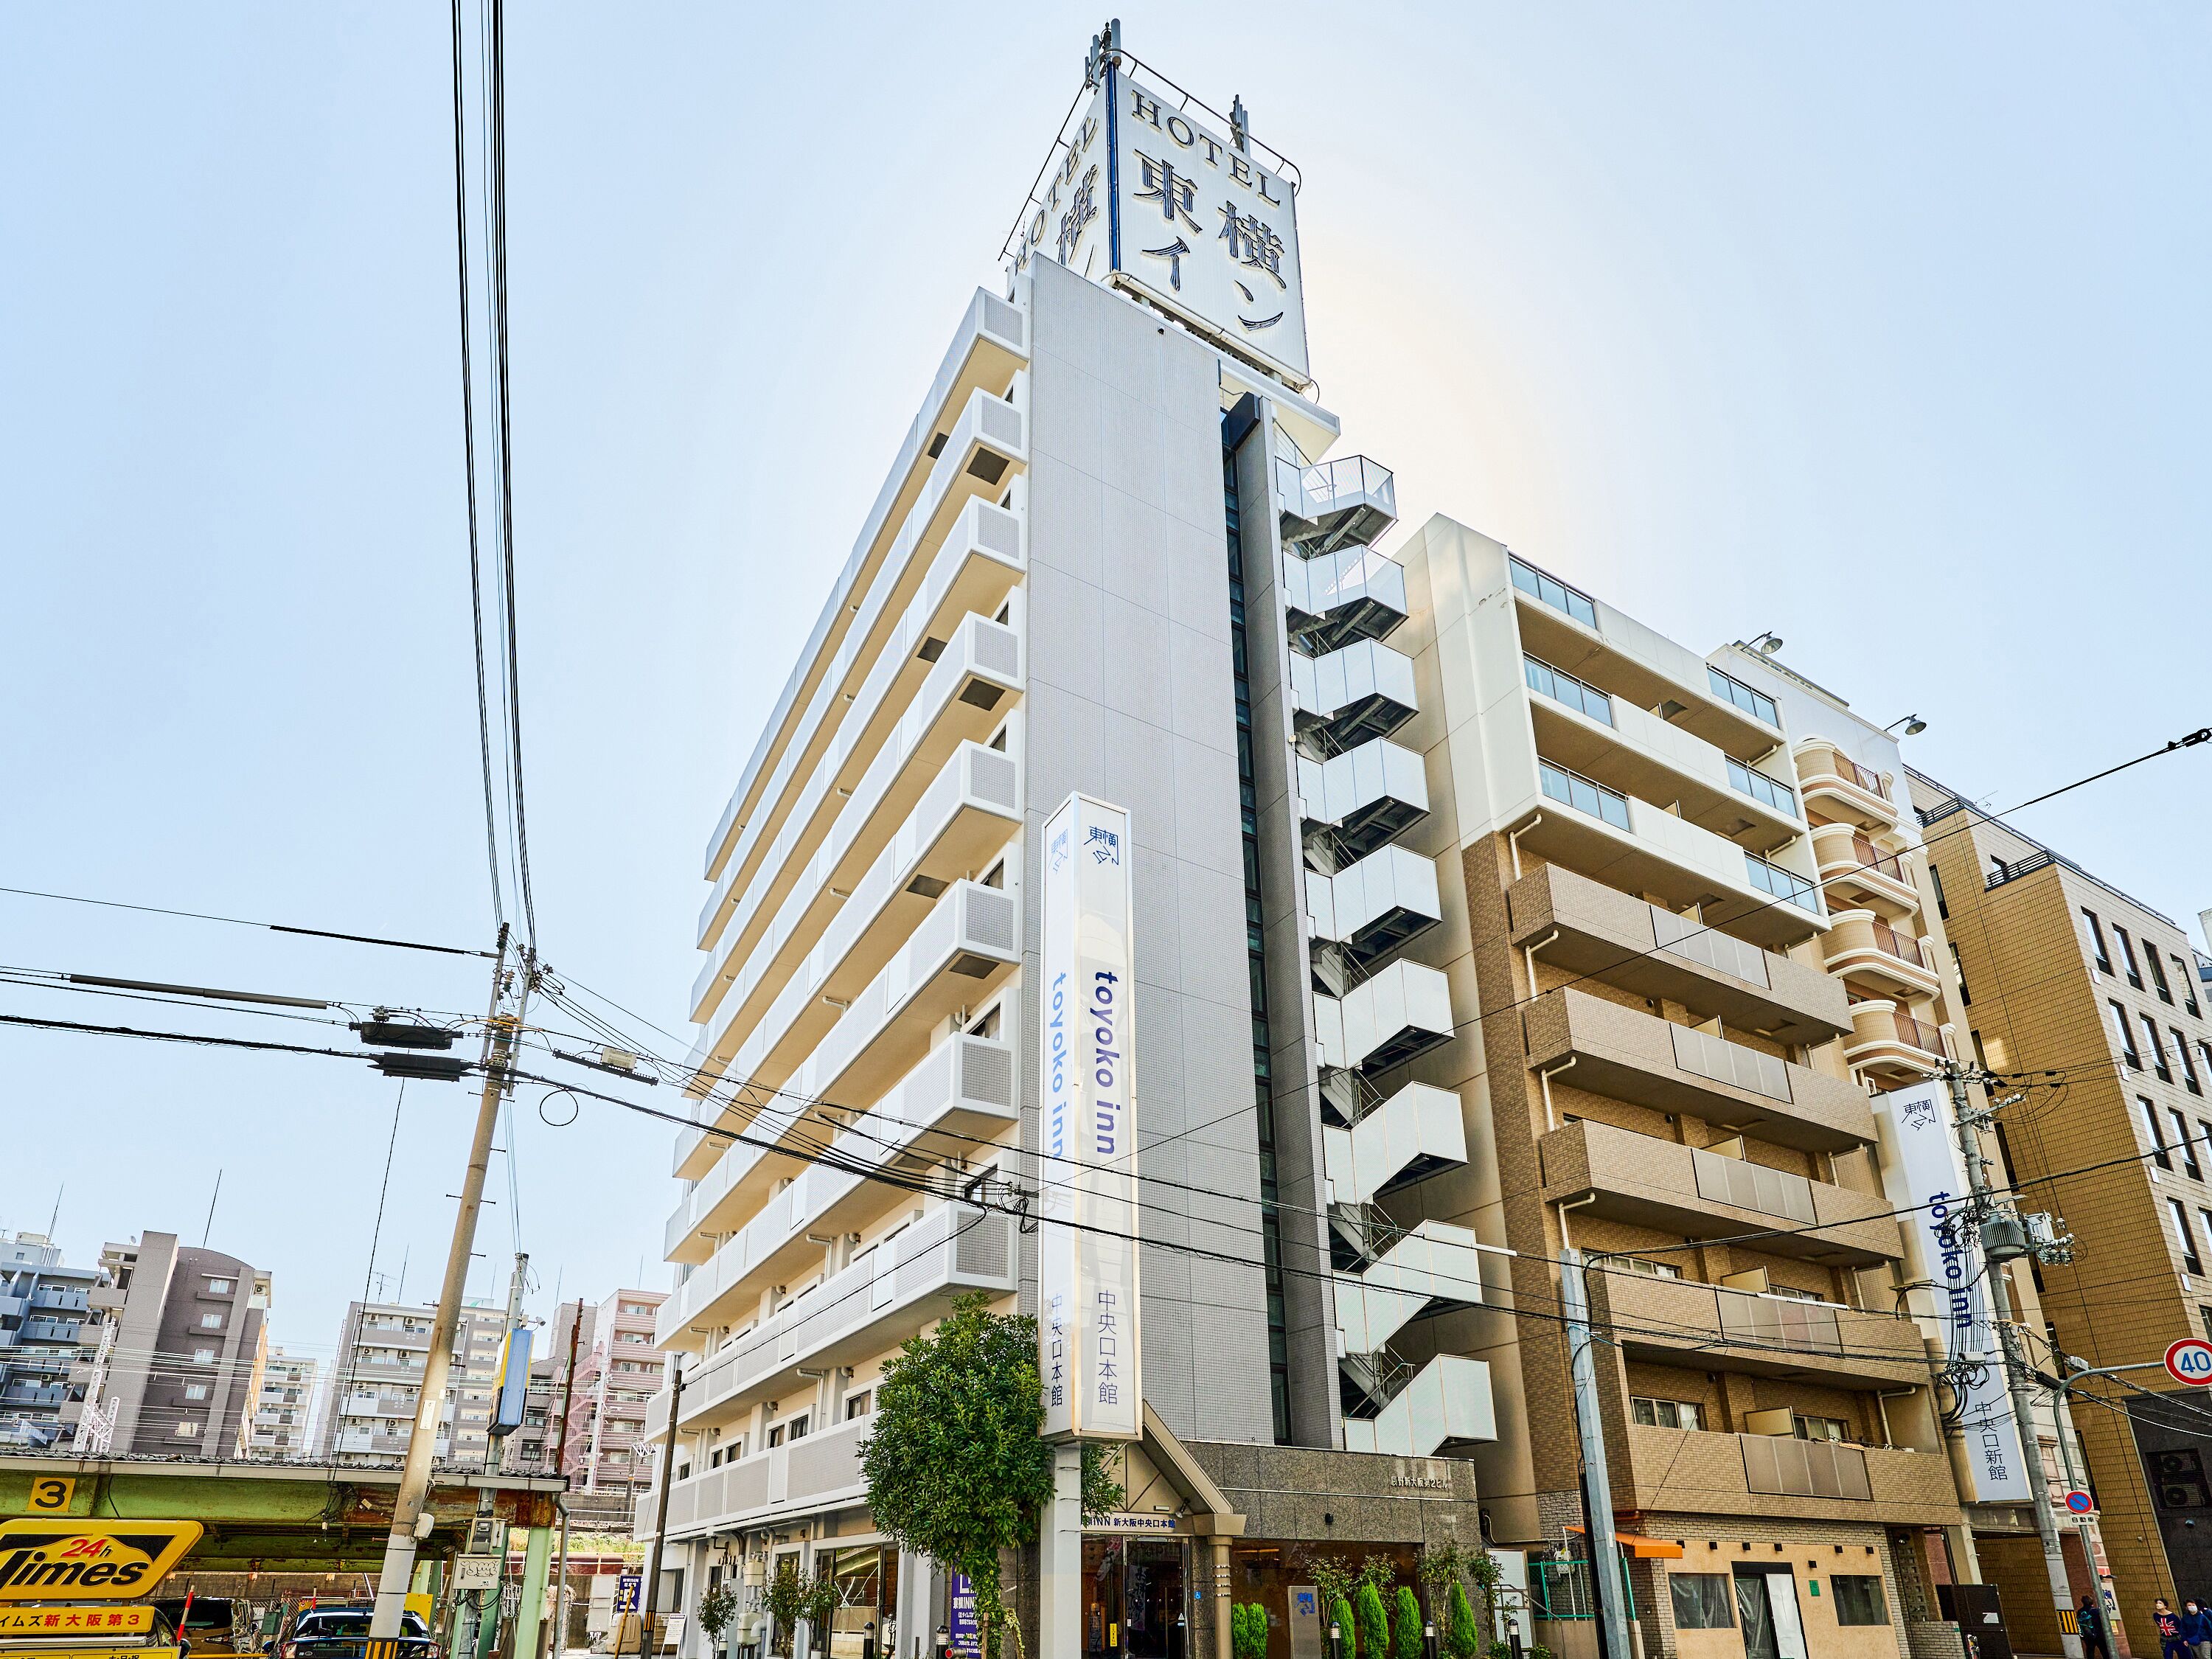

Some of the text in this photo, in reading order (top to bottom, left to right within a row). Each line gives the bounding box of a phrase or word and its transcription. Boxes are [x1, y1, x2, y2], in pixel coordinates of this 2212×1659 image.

[1133, 89, 1281, 207] HOTEL
[1133, 150, 1287, 291] 東横
[1141, 237, 1284, 333] イン
[1049, 972, 1067, 1160] toyoko inn
[1090, 971, 1121, 1155] toyoko inn
[1929, 1191, 1973, 1328] toyoko inn
[1051, 1293, 1063, 1407] 中央口本館
[1098, 1290, 1118, 1405] 中央口本館
[2181, 1351, 2211, 1372] 40
[35, 1481, 66, 1508] 3
[1975, 1401, 2008, 1481] 中央口新館
[60, 1539, 112, 1558] 24h
[1113, 1517, 1176, 1528] 新大阪中央口本館
